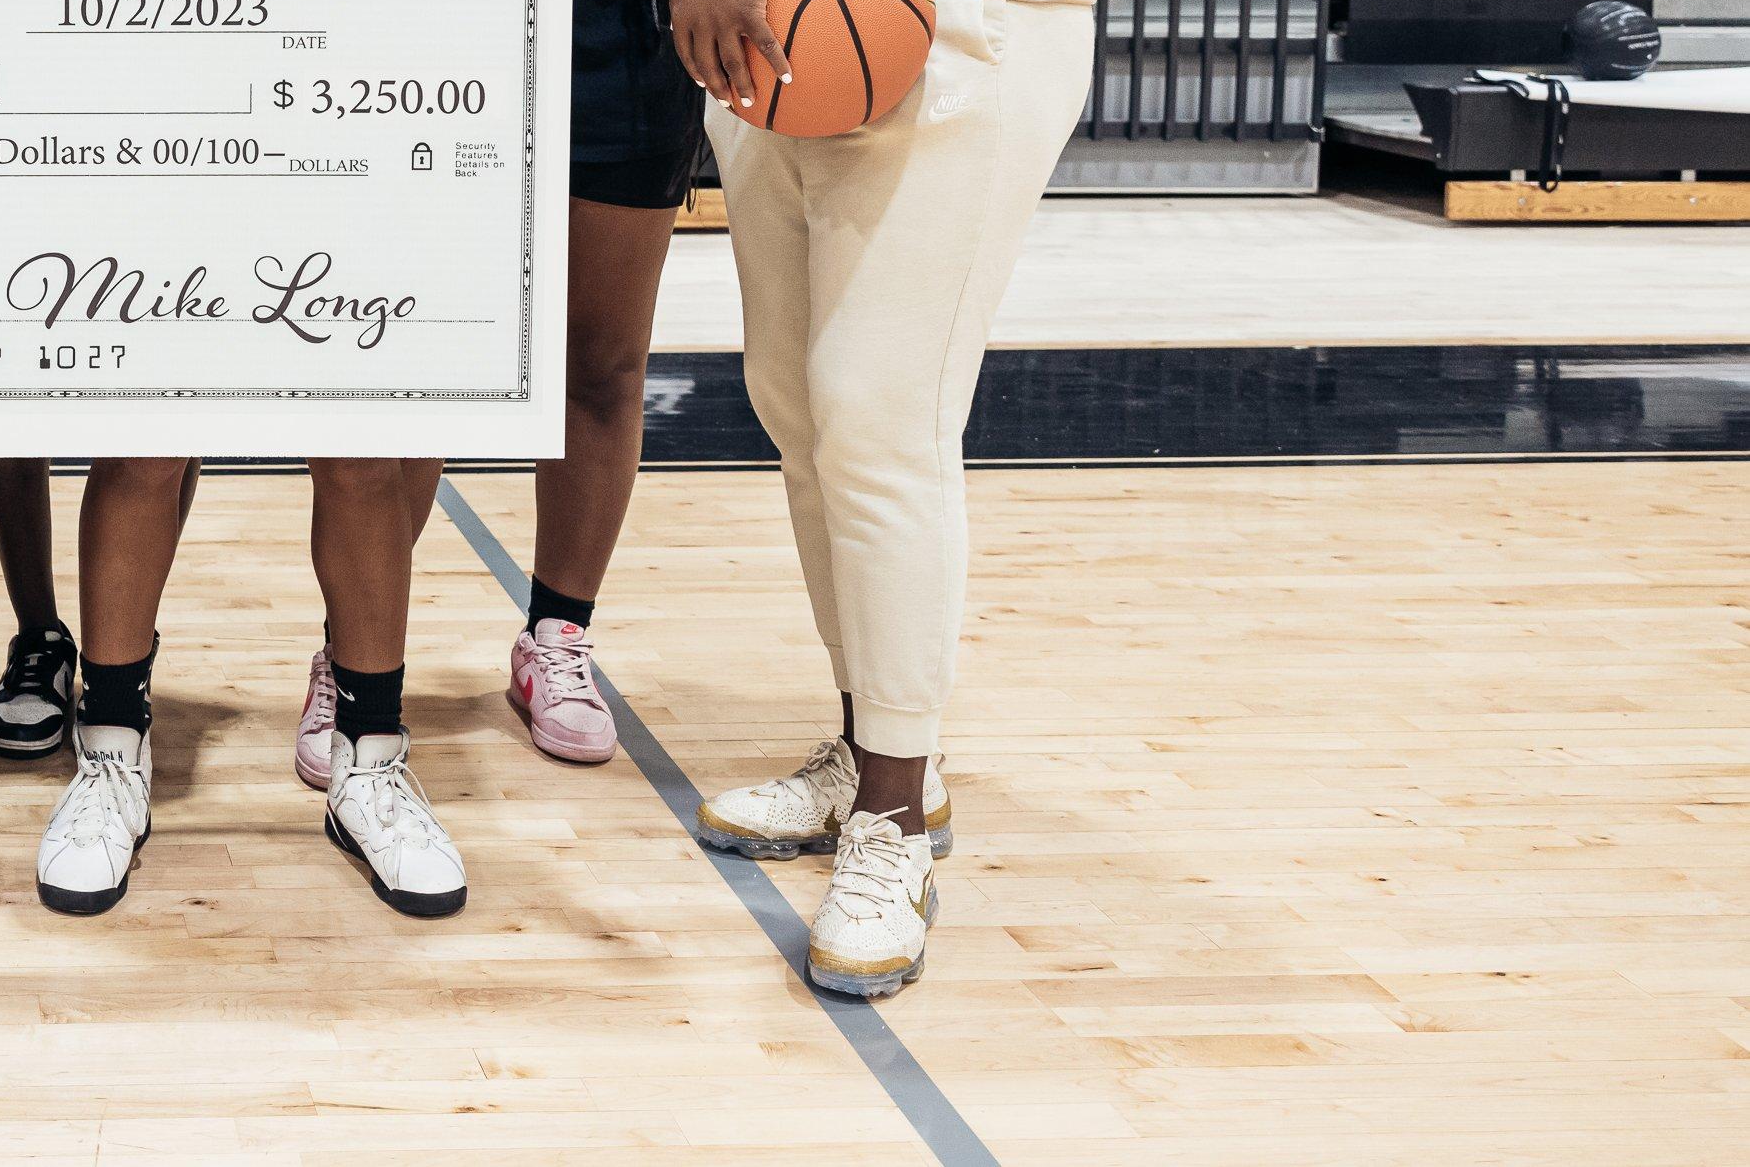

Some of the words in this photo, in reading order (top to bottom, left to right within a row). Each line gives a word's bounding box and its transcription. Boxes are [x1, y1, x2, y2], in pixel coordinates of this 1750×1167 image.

[282, 36, 327, 50] DATE
[273, 79, 294, 110] $
[311, 79, 486, 120] 3,250.00
[116, 137, 143, 165] &
[455, 142, 496, 151] Security
[455, 151, 498, 159] Features
[289, 158, 369, 173] DOLLARS
[455, 160, 489, 168] Details
[6, 252, 230, 330] Mike
[240, 251, 417, 350] Longo
